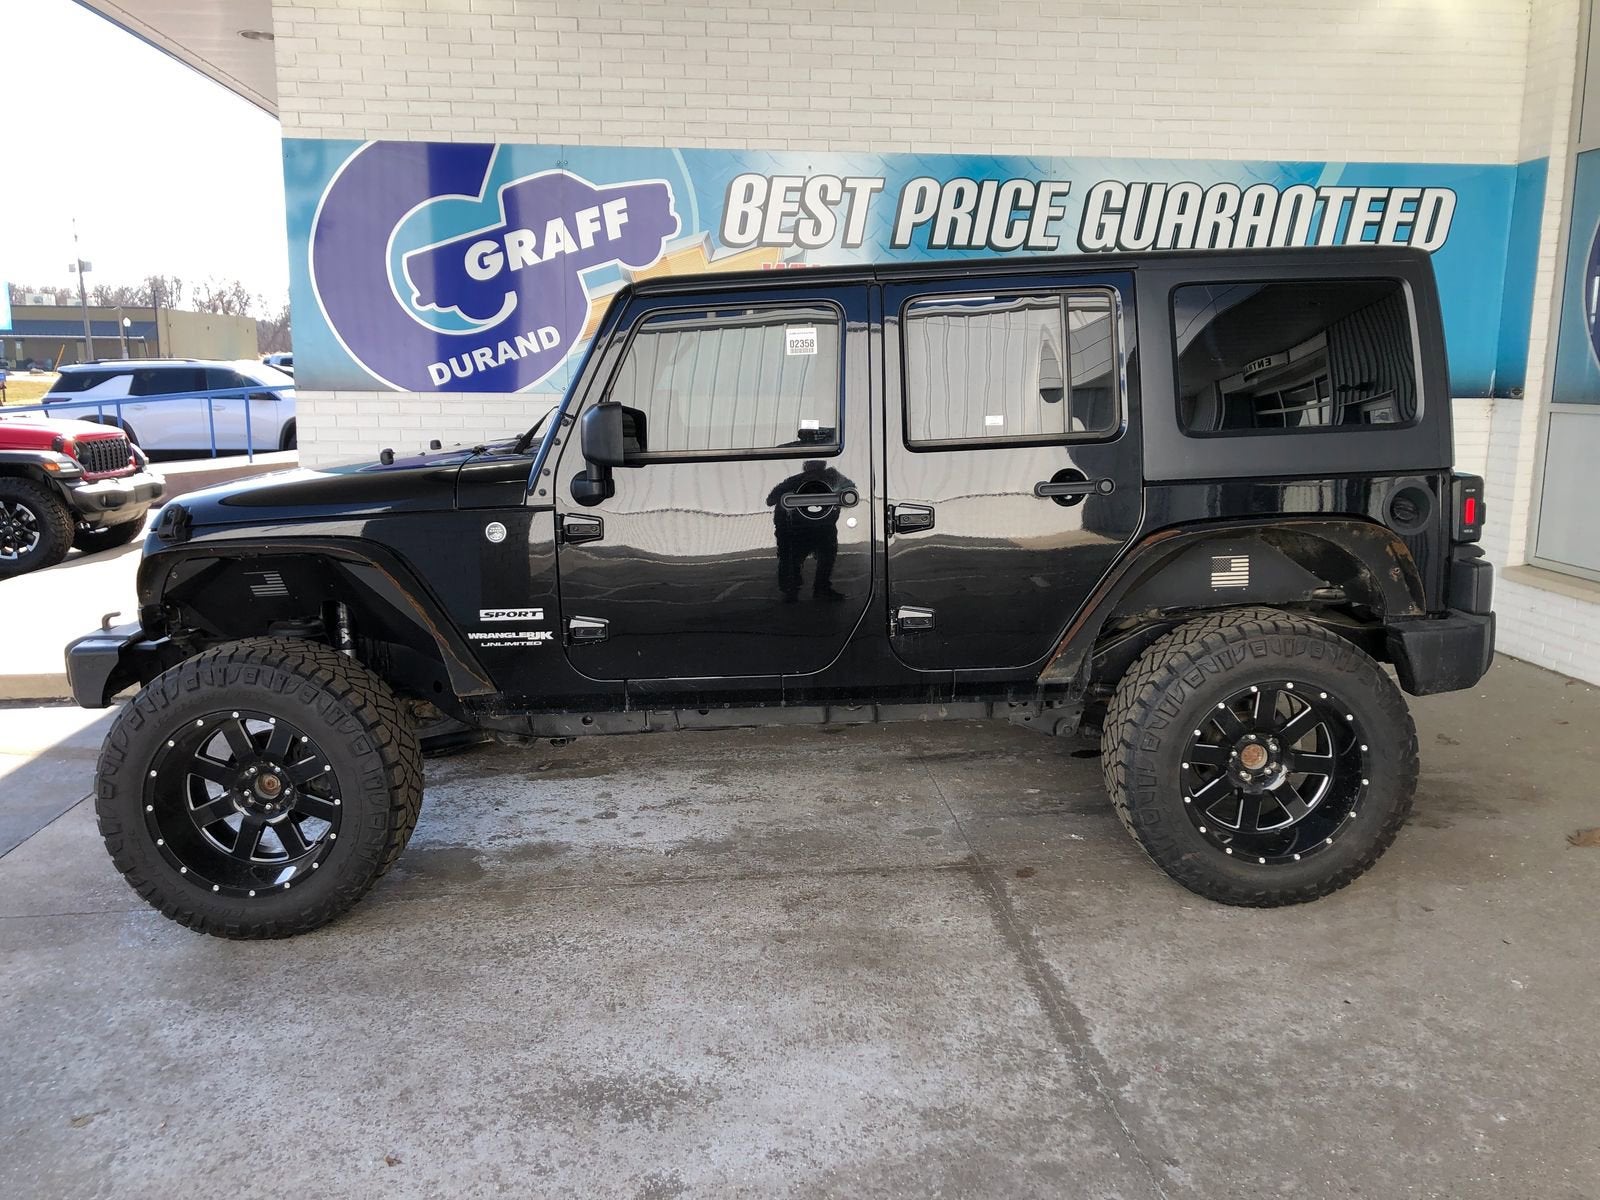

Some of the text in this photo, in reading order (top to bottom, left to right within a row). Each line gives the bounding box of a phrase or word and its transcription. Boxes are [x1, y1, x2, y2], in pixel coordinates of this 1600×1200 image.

[464, 197, 628, 281] GRAFF
[720, 173, 1457, 253] BEST PRICE GUARANTEED
[427, 326, 561, 386] DURAND
[789, 339, 815, 349] 02358
[483, 610, 541, 618] SPORT
